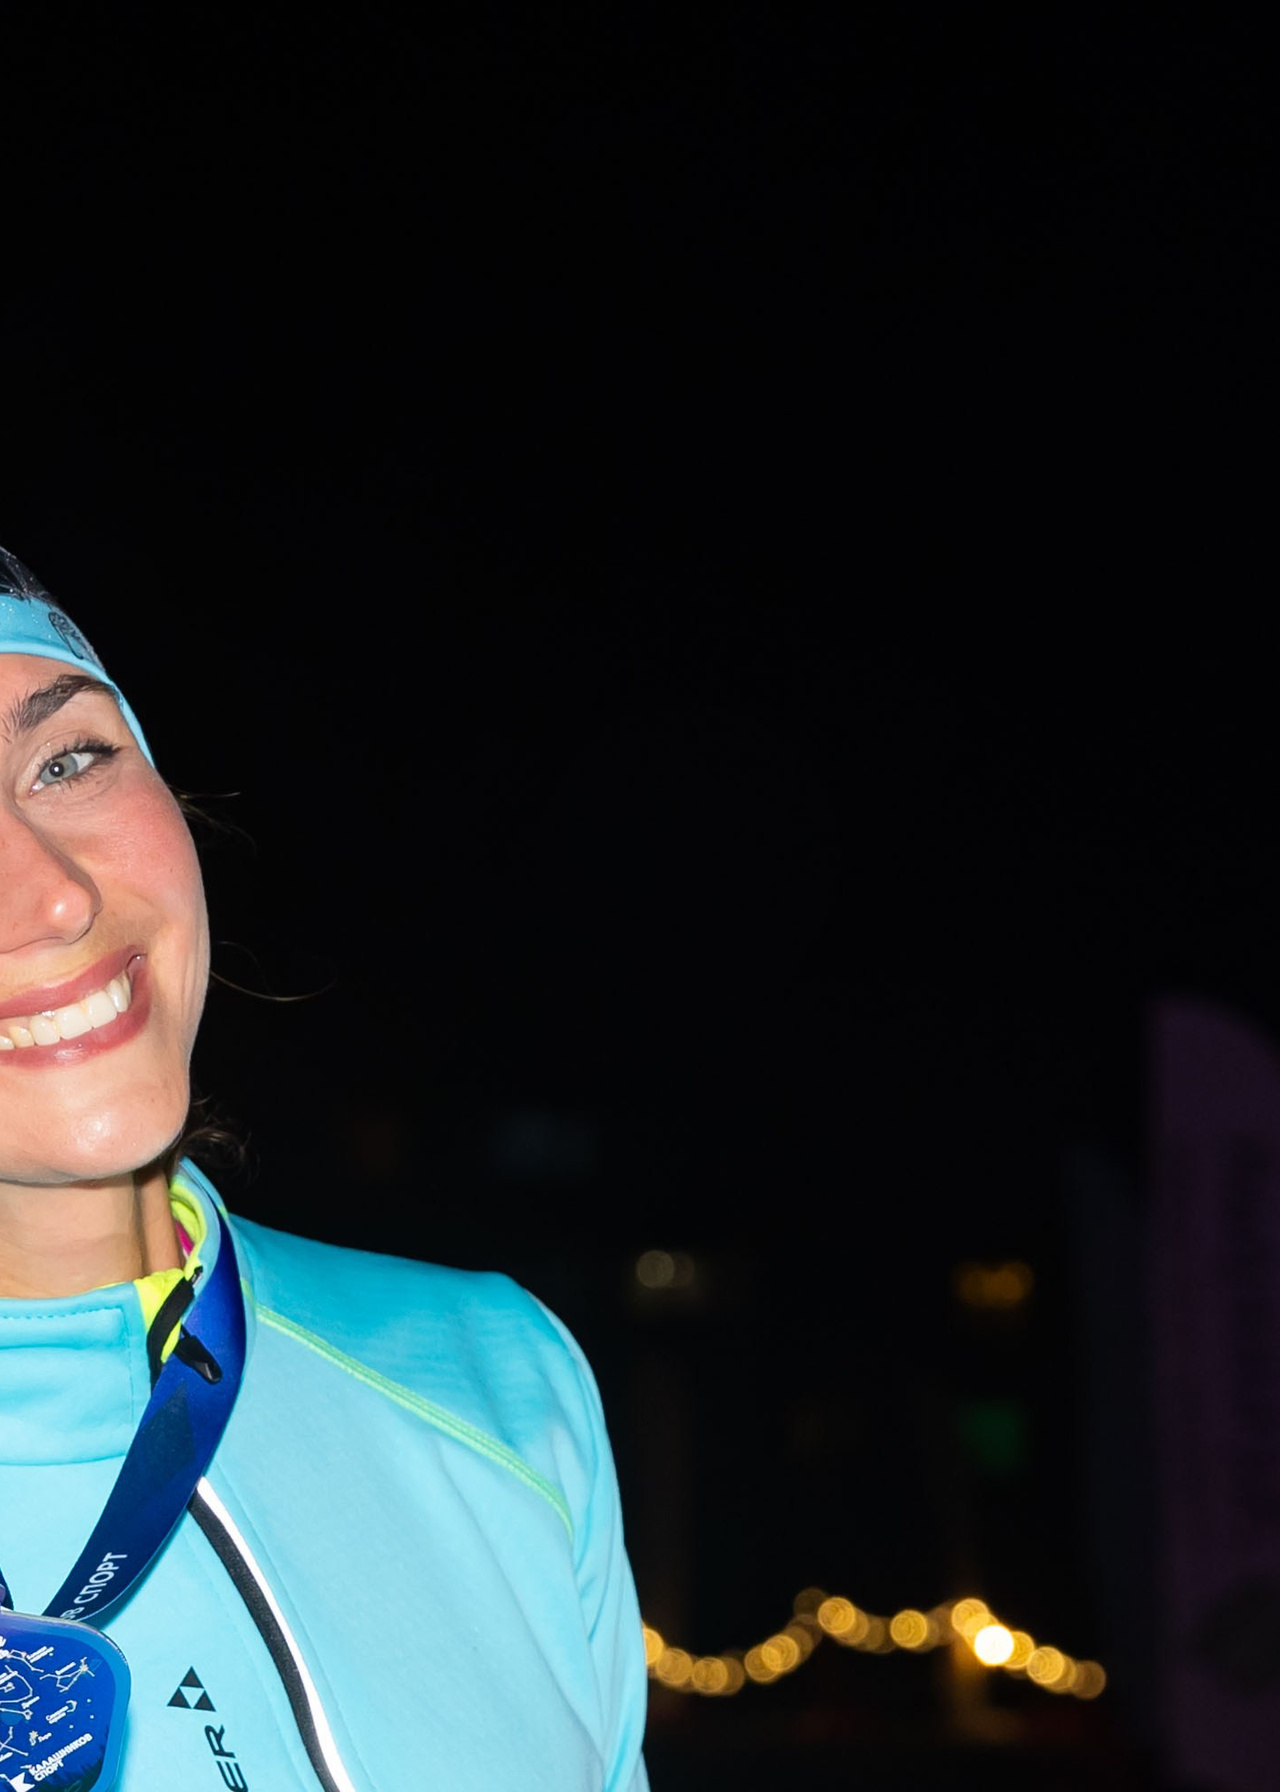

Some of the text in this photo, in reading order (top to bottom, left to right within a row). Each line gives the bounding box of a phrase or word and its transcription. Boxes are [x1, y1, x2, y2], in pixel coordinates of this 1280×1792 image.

[73, 1552, 128, 1604] СПОРТ
[28, 1733, 93, 1776] КАЛАШНИКОВ
[34, 1759, 64, 1781] СПОРТ
